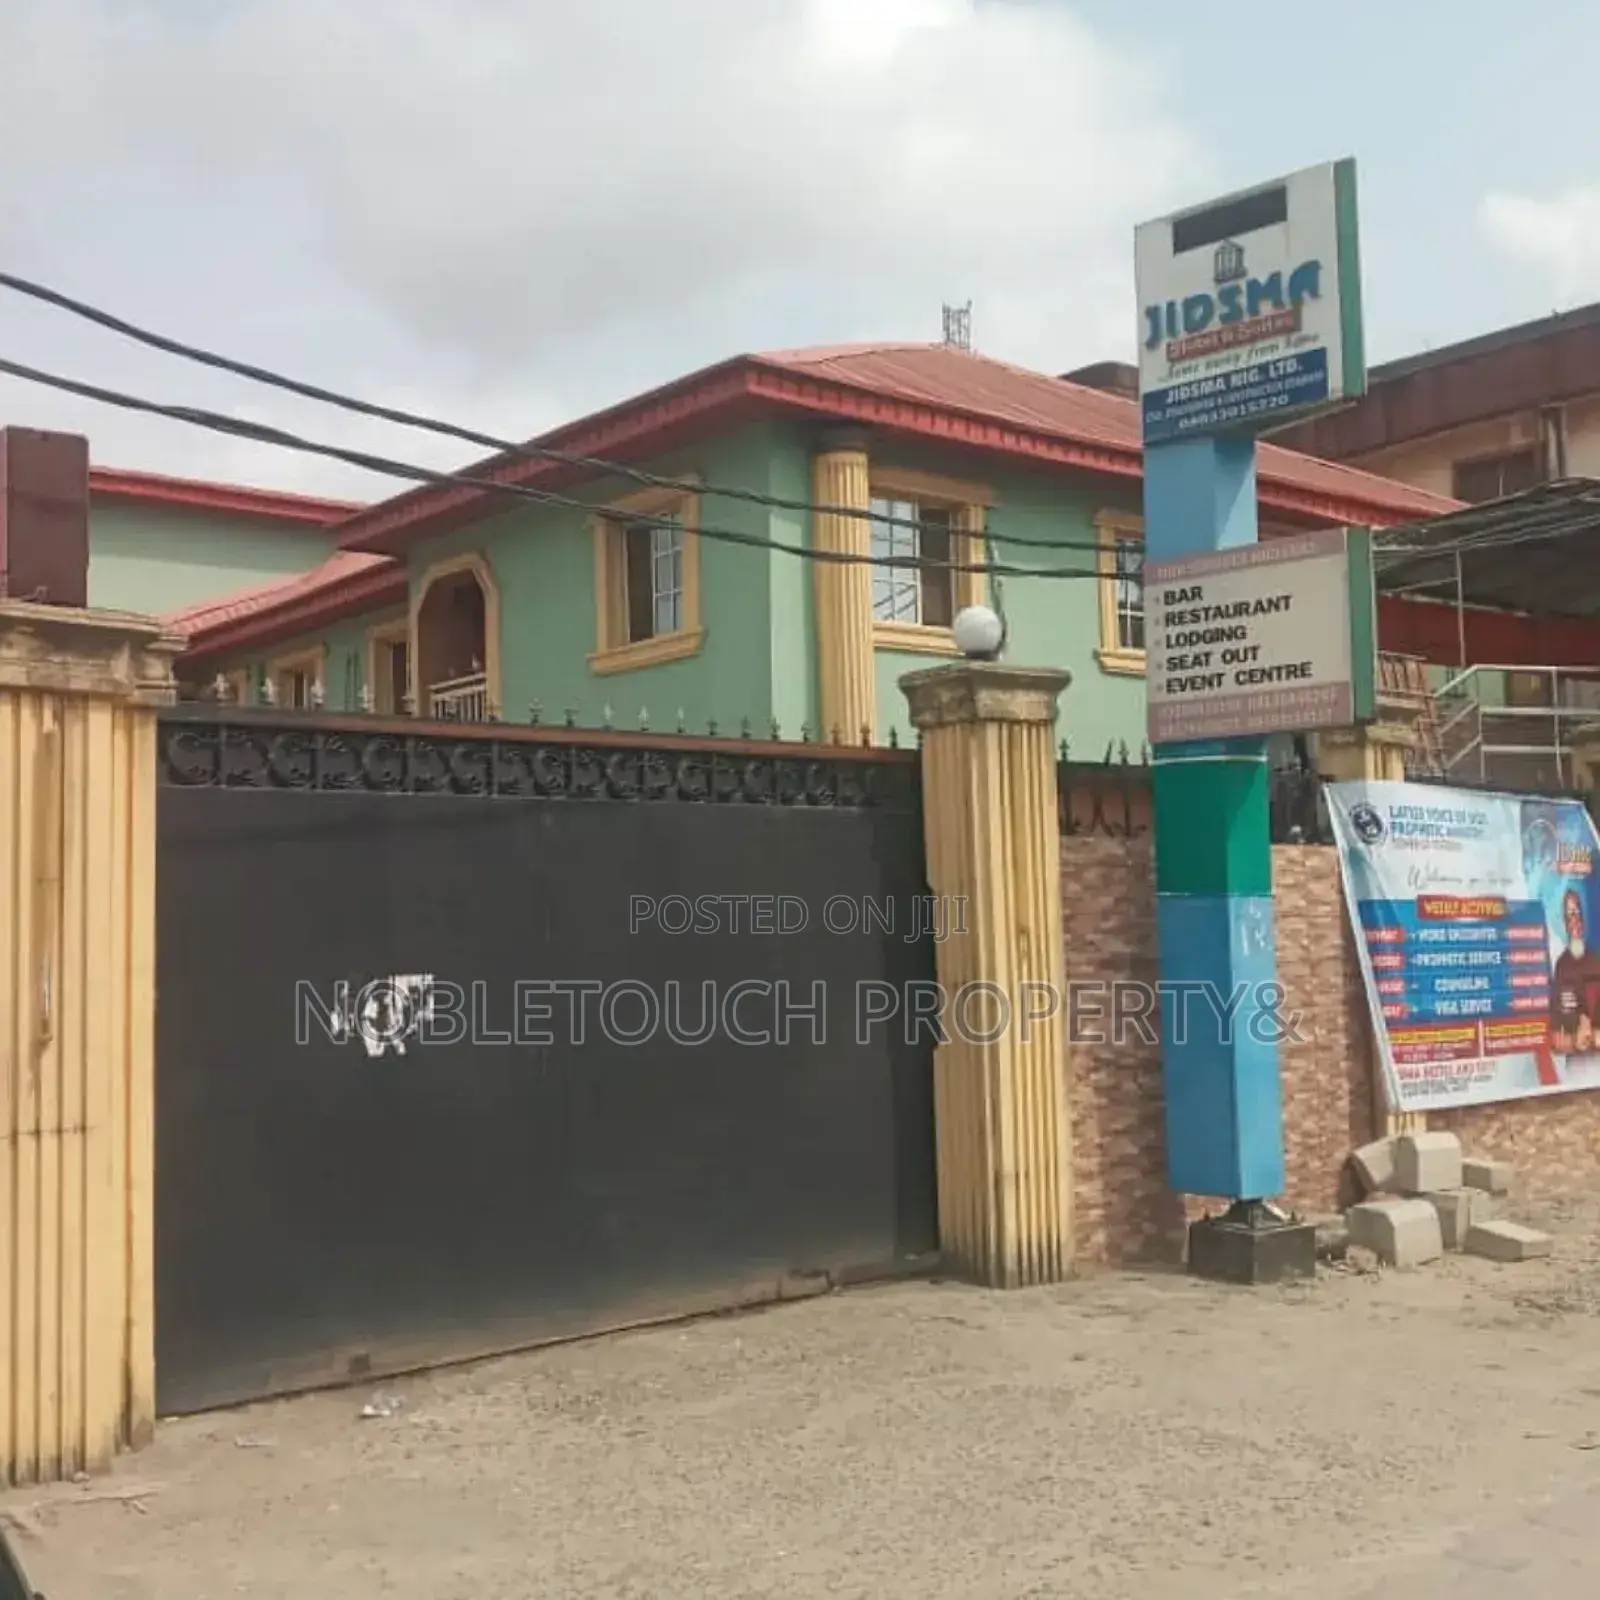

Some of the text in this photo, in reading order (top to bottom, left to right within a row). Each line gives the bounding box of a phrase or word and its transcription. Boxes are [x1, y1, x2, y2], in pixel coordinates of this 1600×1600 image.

[1145, 260, 1322, 352] JIDSMA
[1167, 379, 1226, 404] JIDSMA
[1269, 358, 1304, 379] LTD.
[1163, 585, 1204, 606] BAR
[1164, 594, 1293, 628] RESTAURANT
[1165, 625, 1248, 649] LODGING
[1166, 644, 1261, 672] SEAT OUT
[1166, 661, 1314, 694] EVENT CENTRE
